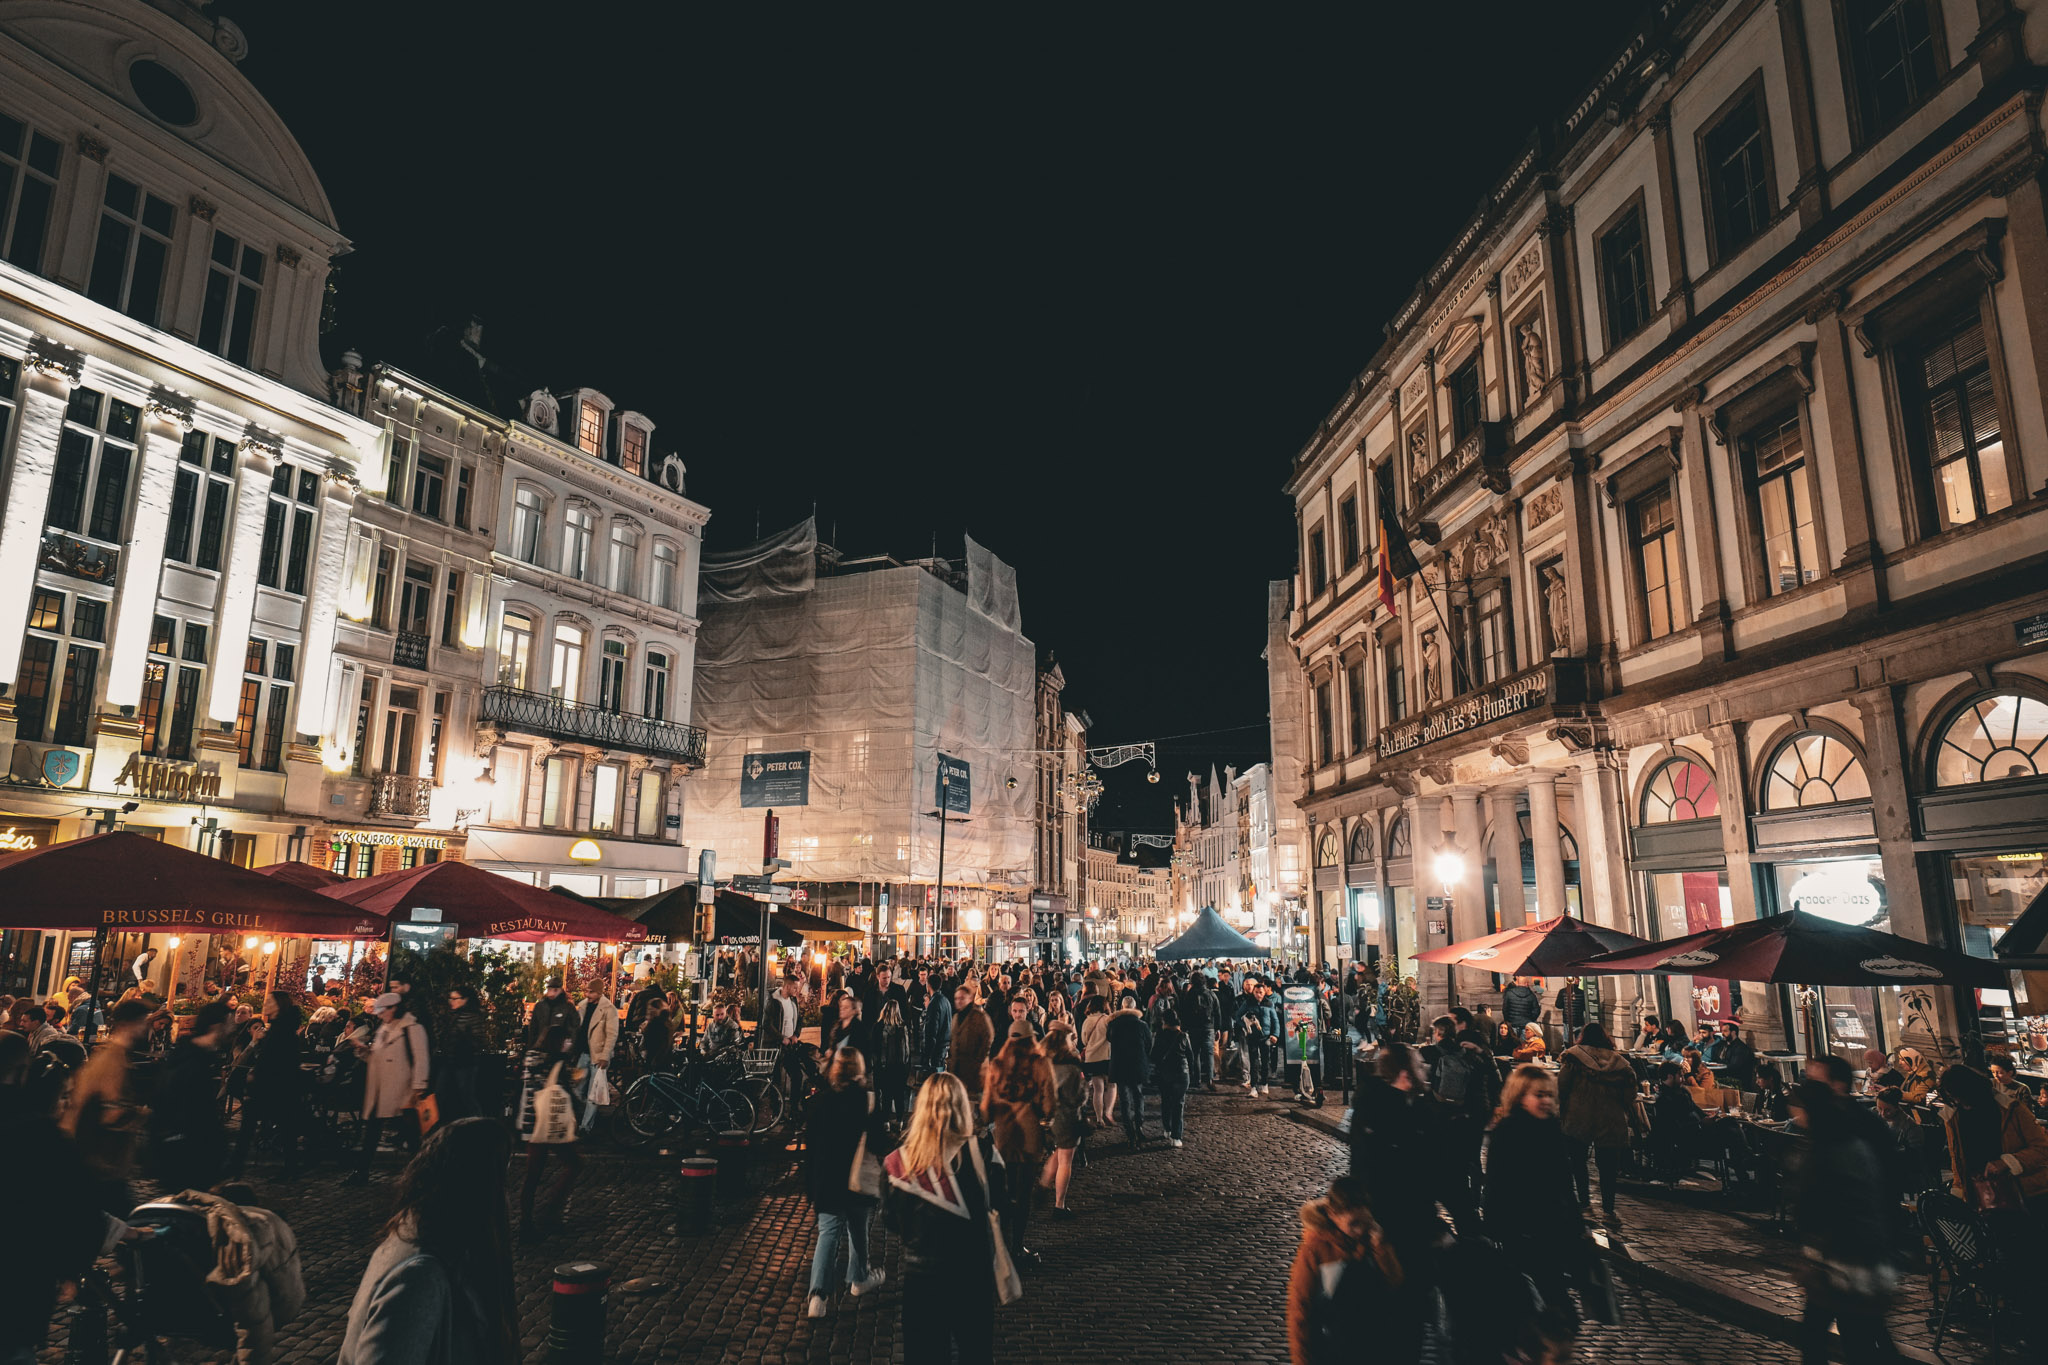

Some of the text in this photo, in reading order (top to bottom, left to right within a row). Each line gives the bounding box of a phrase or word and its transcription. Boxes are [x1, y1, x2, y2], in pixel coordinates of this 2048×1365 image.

[1430, 268, 1483, 334] OMNIBUS OMNIA
[1379, 732, 1420, 758] GALERIES
[1424, 714, 1466, 744] ROYALES
[1483, 689, 1530, 722] HUBERT
[766, 762, 787, 772] PETER
[788, 761, 802, 770] COX
[948, 766, 960, 777] PETER
[114, 760, 222, 800] Affligem
[396, 835, 405, 847] &
[407, 836, 447, 850] WAFFLE
[103, 909, 264, 928] BRUSSELS GRILL
[490, 917, 568, 934] RESTAURANT
[643, 934, 667, 943] AFFLE
